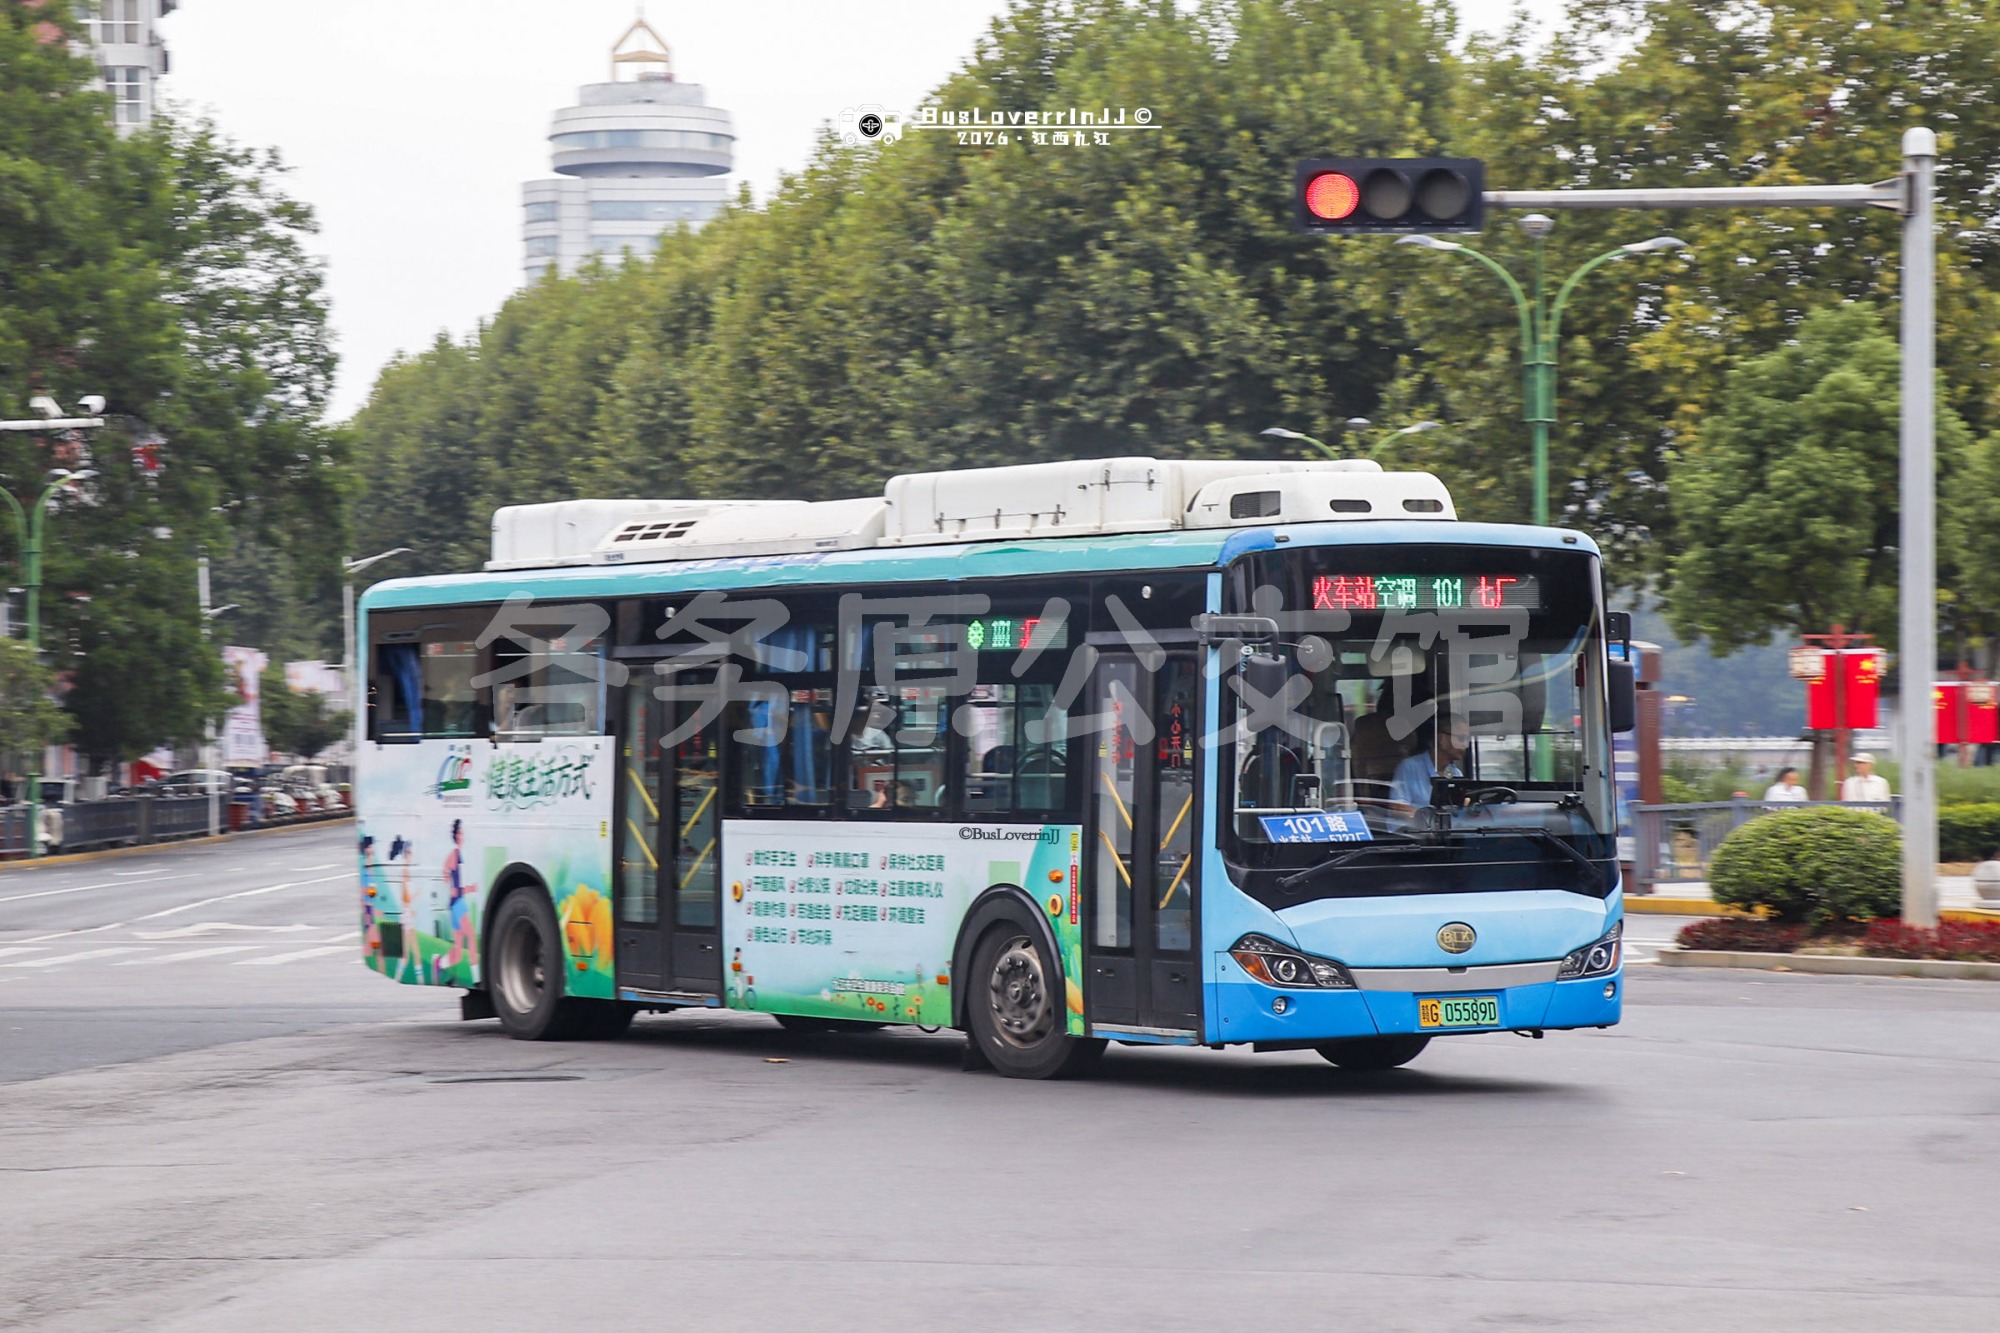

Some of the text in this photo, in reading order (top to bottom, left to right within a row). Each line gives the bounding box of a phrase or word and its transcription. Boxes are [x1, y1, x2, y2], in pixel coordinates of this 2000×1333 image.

[1432, 577, 1462, 608] 101
[486, 754, 595, 800] 健康生活方式
